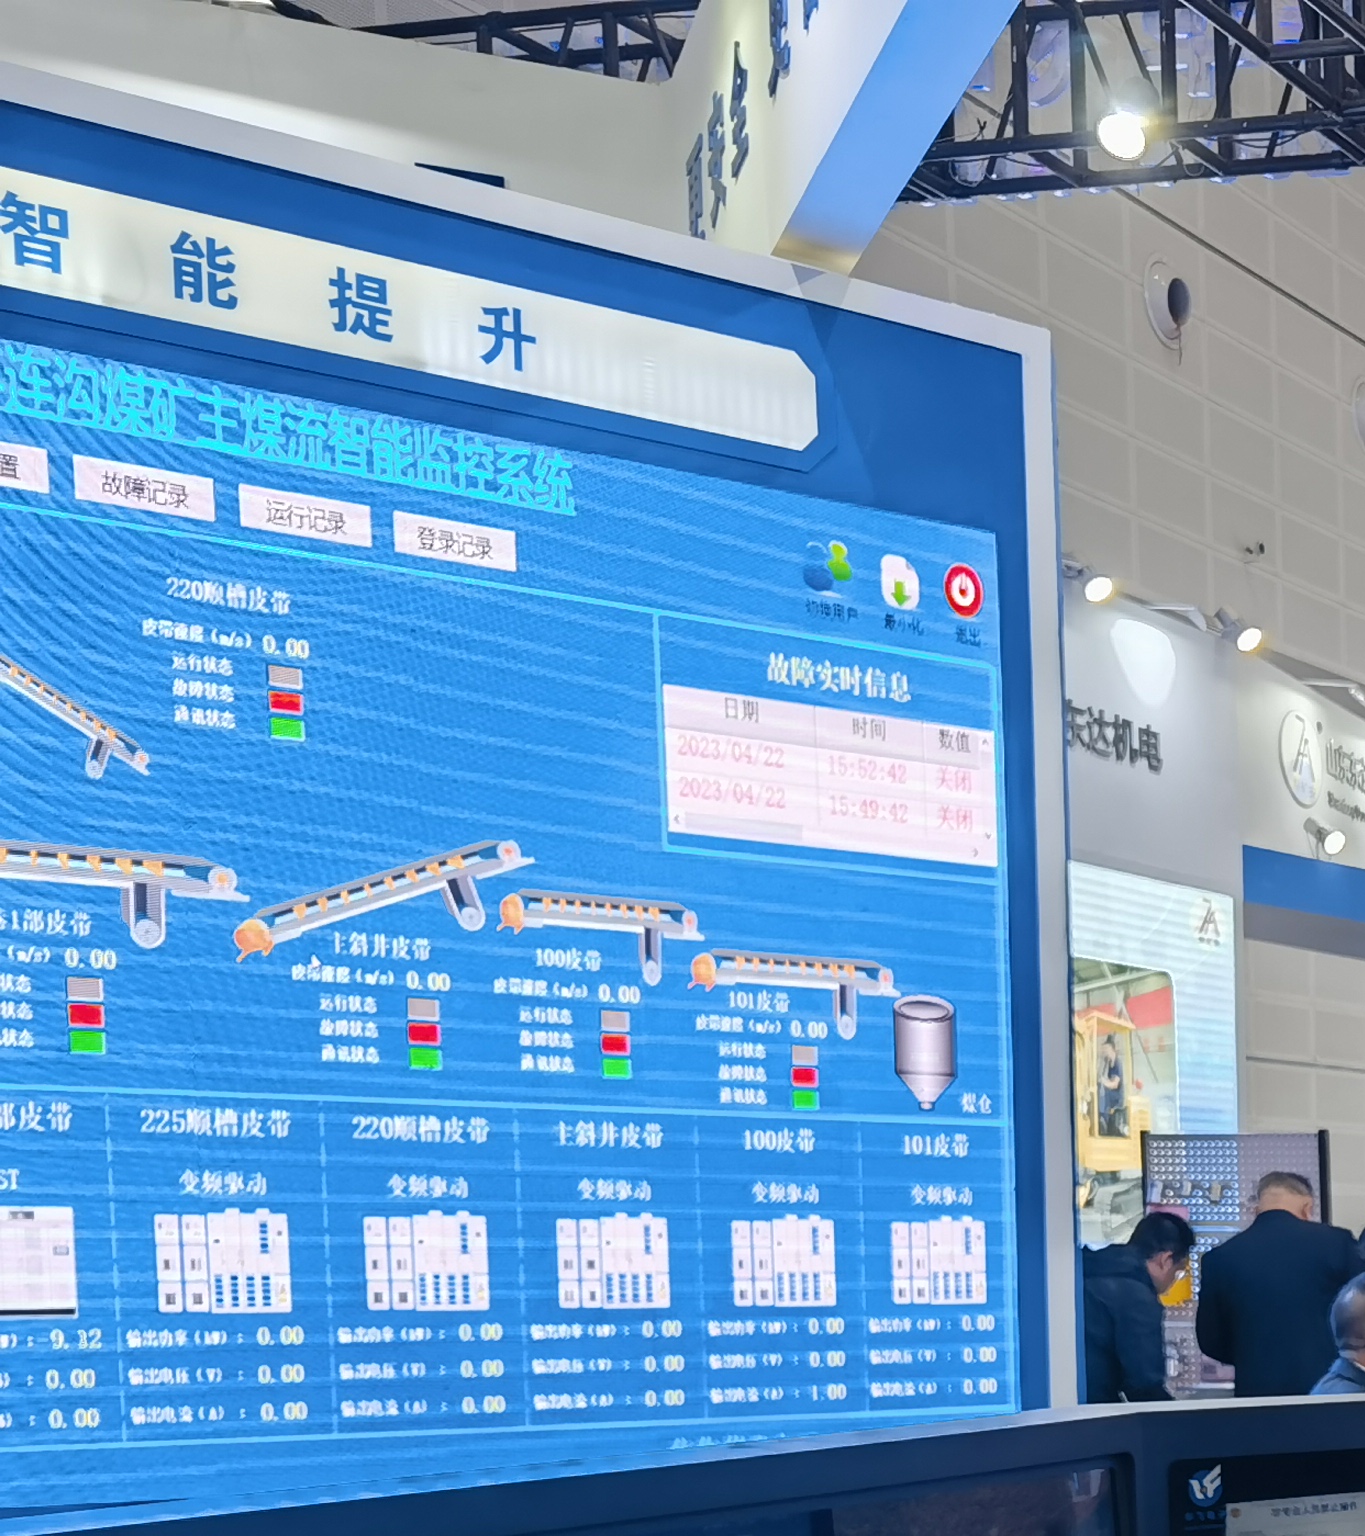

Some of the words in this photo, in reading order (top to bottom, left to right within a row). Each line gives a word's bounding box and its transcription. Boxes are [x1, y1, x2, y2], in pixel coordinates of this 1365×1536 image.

[0, 343, 577, 516] 连沟煤矿主煤流智能监控系统
[101, 470, 189, 510] 故障记录
[266, 499, 347, 537] 运行记录
[417, 526, 494, 561] 登录记录
[262, 634, 310, 659] 0.00
[767, 652, 911, 702] 故障实时信息
[724, 697, 759, 722] 日期
[851, 717, 886, 742] 时间
[938, 728, 971, 753] 数值
[1066, 698, 1163, 775] 东达机电
[677, 734, 785, 768] 2023/04/22
[936, 767, 973, 794] 关闭
[679, 776, 786, 810] 2023/04/22
[936, 808, 973, 832] 关闭
[64, 947, 117, 970] 0.00
[406, 970, 451, 991] 0.00
[598, 983, 641, 1004] 0.00
[790, 1019, 828, 1039] 0.00
[140, 1108, 291, 1138] 225顺槽皮带
[352, 1114, 491, 1144] 220顺槽皮带
[556, 1120, 664, 1149] 主斜井皮带
[743, 1127, 816, 1154] 100皮带
[902, 1133, 970, 1158] 101皮带
[178, 1167, 267, 1196] 变频驱动
[387, 1173, 470, 1200] 变频驱动
[577, 1177, 653, 1204] 变频驱动
[751, 1180, 820, 1206] 变频驱动
[910, 1183, 973, 1207] 变频驱动
[458, 1322, 504, 1342] 0.00
[642, 1319, 683, 1338] 0.00
[808, 1317, 845, 1334] 0.00
[961, 1314, 995, 1332] 0.00
[256, 1325, 305, 1346] 0.00
[644, 1355, 685, 1373] 0.00
[809, 1350, 846, 1368] 0.00
[963, 1346, 997, 1363] 0.00
[45, 1368, 97, 1390] 0.00
[257, 1363, 306, 1385] 0.00
[460, 1359, 505, 1378] 0.00
[644, 1389, 686, 1407] 0.00
[812, 1383, 847, 1401] 1.00
[963, 1378, 998, 1395] 0.00
[260, 1401, 308, 1422] 0.00
[462, 1395, 507, 1414] 0.00
[48, 1407, 101, 1429] 0.00
